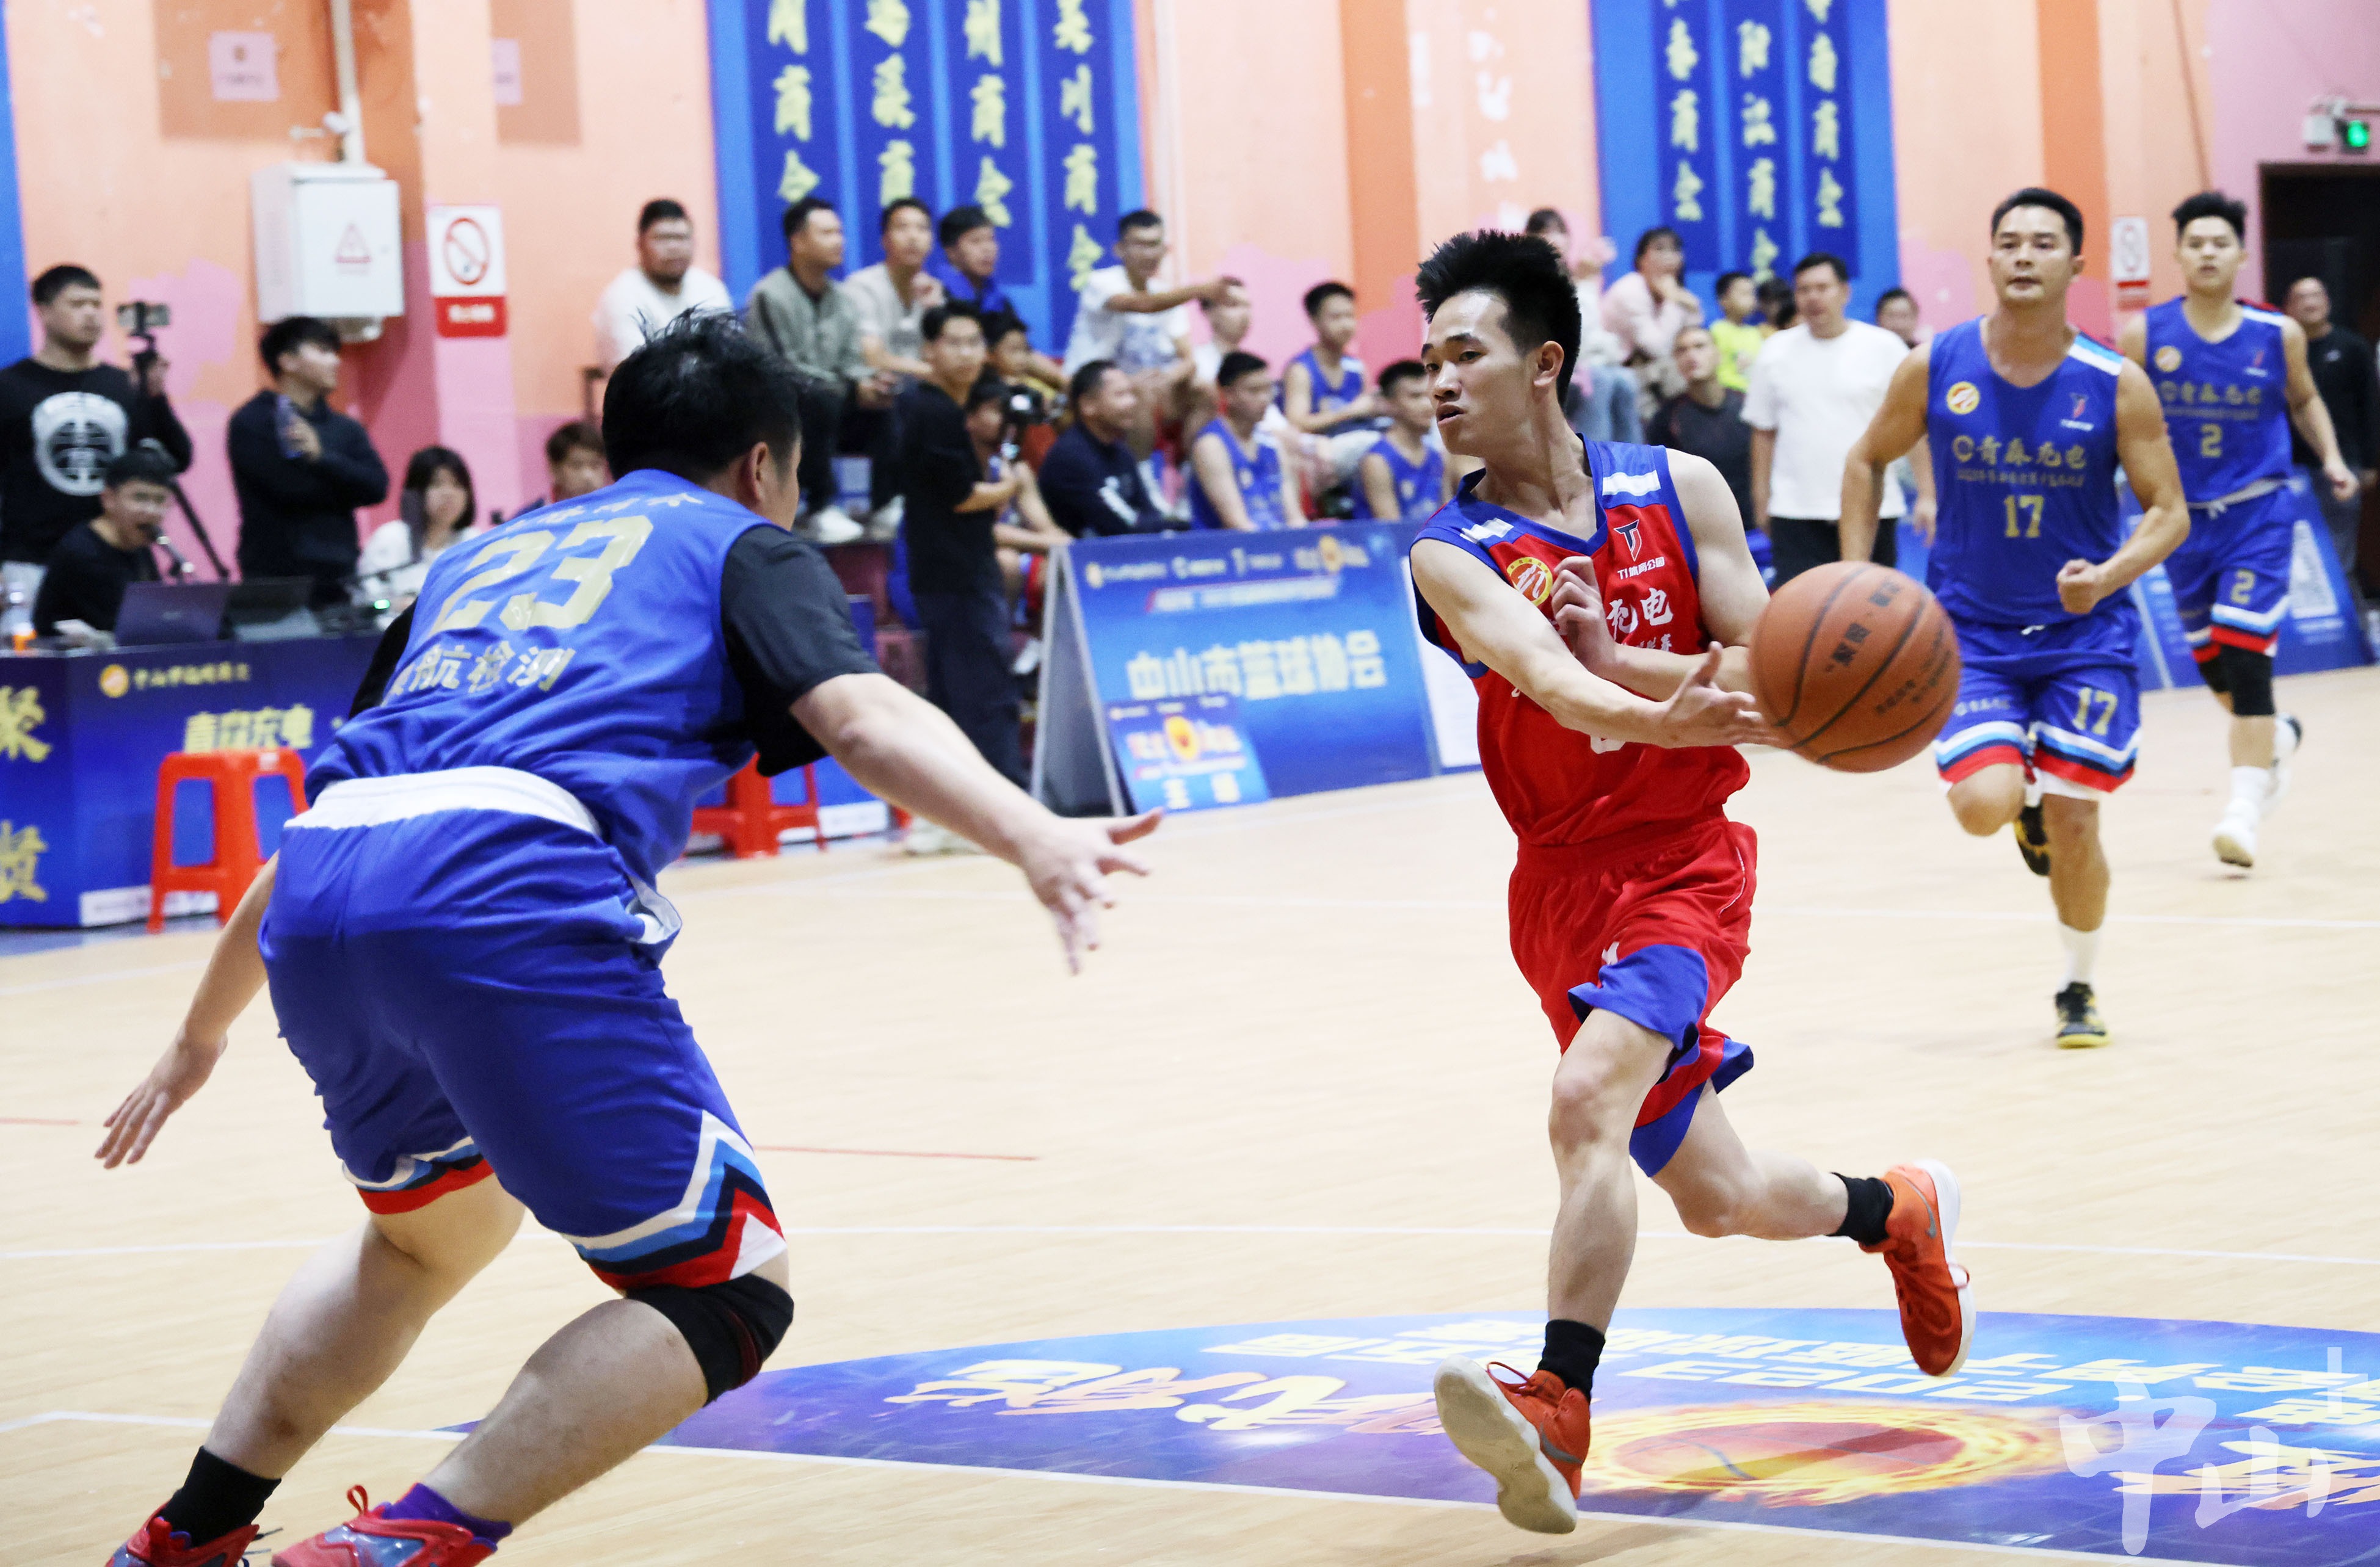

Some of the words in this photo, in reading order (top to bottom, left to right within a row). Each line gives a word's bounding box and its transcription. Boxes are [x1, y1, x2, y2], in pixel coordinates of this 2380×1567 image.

[2200, 423, 2222, 457] 2
[2004, 494, 2045, 538] 17
[424, 514, 653, 641] 23
[2230, 568, 2255, 605] 2
[2072, 687, 2118, 736] 17
